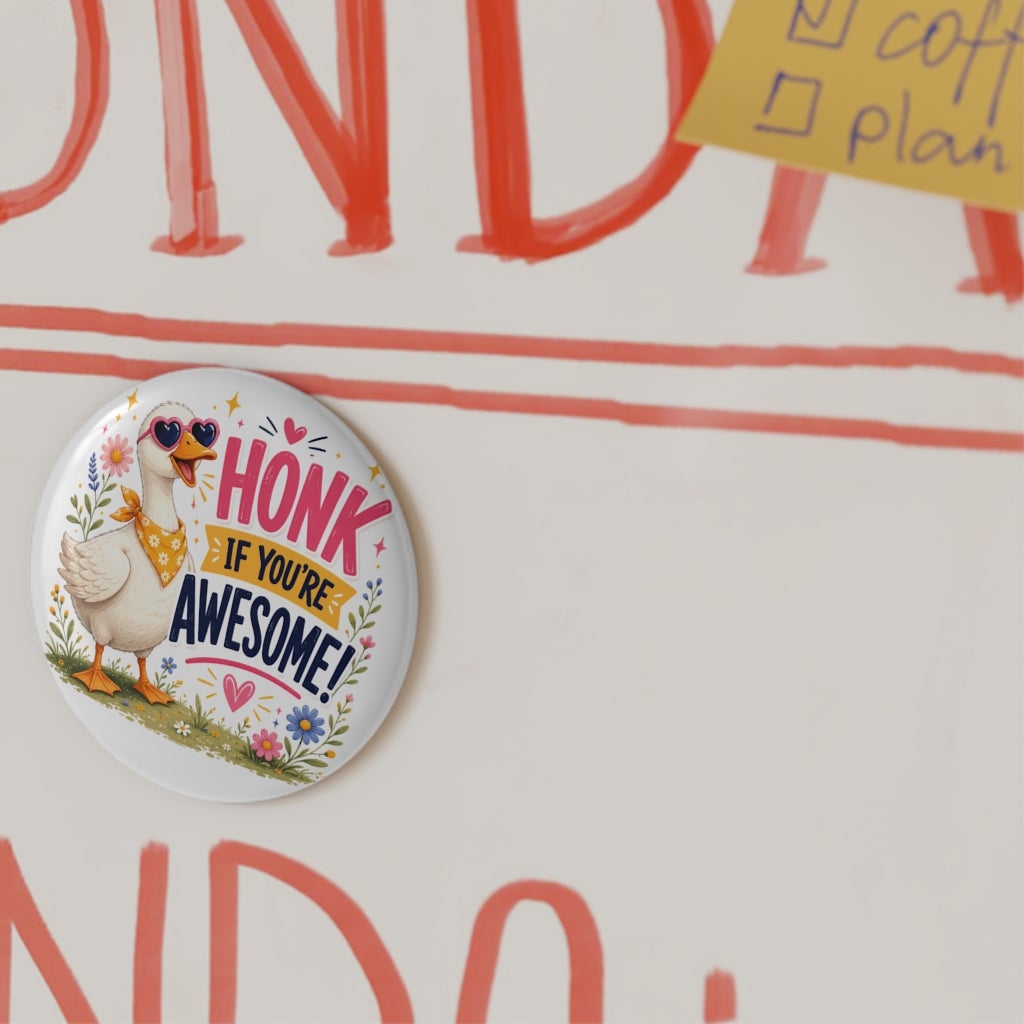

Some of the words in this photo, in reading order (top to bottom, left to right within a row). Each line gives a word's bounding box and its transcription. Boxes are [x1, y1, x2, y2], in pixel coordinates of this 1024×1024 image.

[847, 88, 1011, 174] plan
[216, 436, 393, 576] HONK
[224, 537, 252, 572] IF
[258, 545, 334, 611] YOU'RE
[169, 573, 355, 704] AWESOME!
